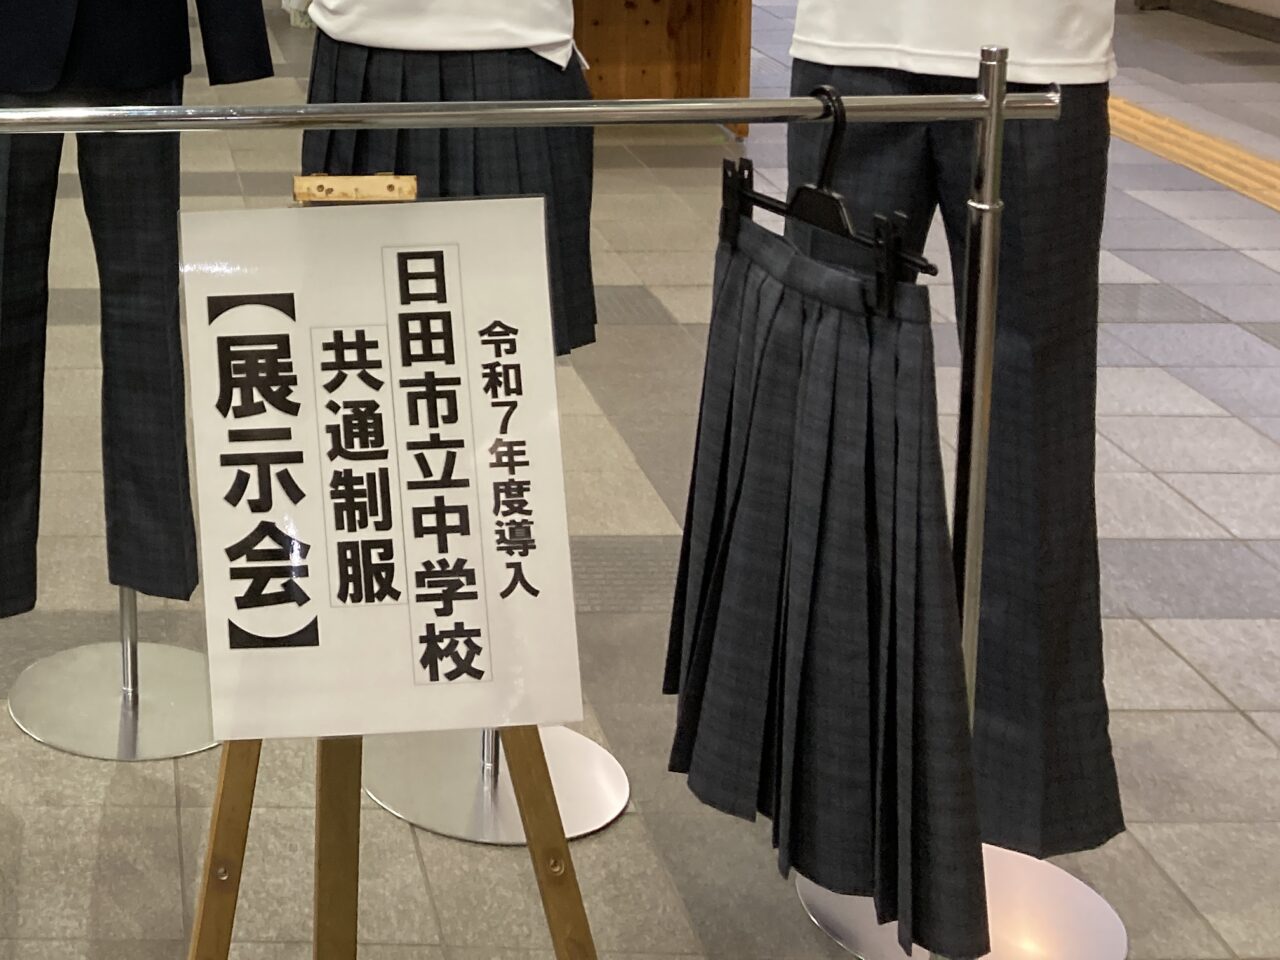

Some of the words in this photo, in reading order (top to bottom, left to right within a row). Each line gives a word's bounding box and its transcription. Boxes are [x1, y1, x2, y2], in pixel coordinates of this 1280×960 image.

[206, 291, 320, 650] 【展示会】
[321, 328, 402, 604] 共通制服
[397, 250, 485, 682] 日田市立中学校
[478, 320, 540, 600] 令和7年度導入
